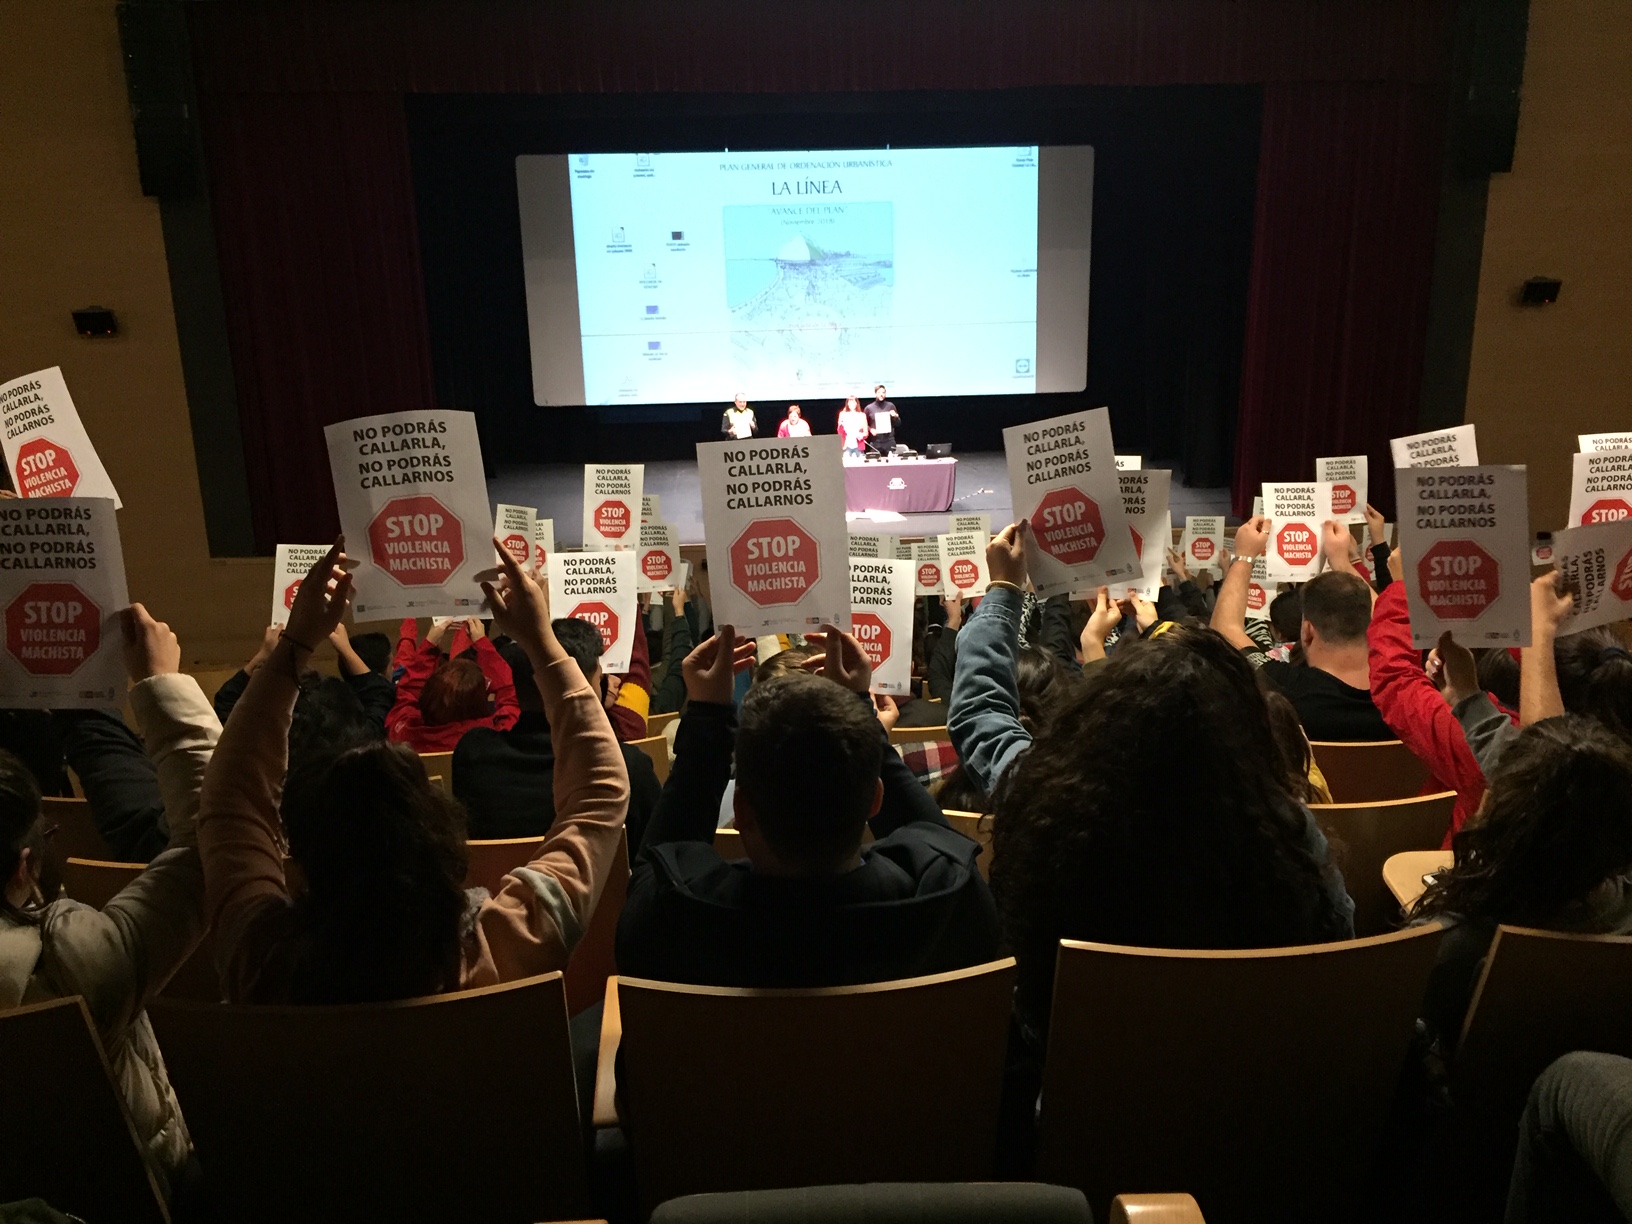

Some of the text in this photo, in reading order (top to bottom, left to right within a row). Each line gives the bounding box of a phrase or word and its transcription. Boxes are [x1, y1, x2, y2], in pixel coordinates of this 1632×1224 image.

[741, 162, 774, 170] GENERAL
[772, 176, 842, 195] LA LÍNEA
[8, 380, 42, 399] PODRÁS
[2, 393, 43, 414] CALLARLA,
[4, 404, 50, 429] NO PODRÁS
[6, 415, 55, 440] CALLARNOS
[353, 419, 447, 442] NO PODRÁS
[1023, 420, 1086, 444] NO PODRÁS
[359, 437, 446, 456] CALLARLA,
[1027, 435, 1085, 456] CALLARLA,
[724, 445, 809, 463] NO PODRÁS
[1026, 449, 1089, 472] NO PODRÁS
[21, 449, 56, 475] STOP
[358, 453, 452, 475] NO PODRÁS
[728, 462, 807, 477] CALLARLA,
[24, 467, 67, 489] VIOLENCIA
[360, 470, 454, 489] CALLARNOS
[1027, 461, 1092, 485] CALLARNOS
[1416, 473, 1495, 487] NO PODRÁS
[28, 479, 72, 498] MACHISTA
[726, 478, 812, 495] NO PODRÁS
[727, 494, 813, 509] CALLARNOS
[1419, 489, 1491, 500] CALLARLA,
[26, 506, 91, 520] PODRÁS
[602, 508, 625, 518] STOP
[1043, 501, 1086, 528] STOP
[1417, 502, 1495, 516] NO PODRÁS
[1591, 508, 1628, 523] STOP
[1, 523, 90, 537] CALLARLA,
[385, 513, 444, 539] STOP
[1416, 517, 1496, 529] CALLARNOS
[1044, 523, 1094, 542] VIOLENCIA
[1284, 531, 1309, 542] STOP
[0, 540, 95, 554] NO PODRÁS
[384, 541, 450, 555] VIOLENCIA
[747, 536, 800, 559] STOP
[1051, 537, 1097, 555] MACHISTA
[1, 557, 96, 569] CALLARNOS
[389, 557, 451, 572] MACHISTA
[579, 557, 616, 566] PODRÁS
[744, 561, 806, 576] VIOLENCIA
[854, 564, 893, 574] PODRÁS
[1430, 556, 1482, 576] STOP
[566, 567, 614, 575] CALLARLA,
[1582, 551, 1595, 598] PODRÁS
[580, 576, 617, 585] PODRÁS
[748, 576, 806, 592] MACHISTA
[852, 575, 890, 585] LLARLA,
[1427, 580, 1486, 591] VIOLENCIA
[564, 586, 618, 595] CALLARNOS
[853, 586, 892, 596] PODRÁS
[851, 596, 892, 605] LARNOS
[1429, 594, 1486, 606] MACHISTA
[24, 601, 82, 624] STOP
[20, 629, 86, 642] VIOLENCIA
[853, 624, 881, 640] TOP
[21, 646, 84, 660] MACHISTA
